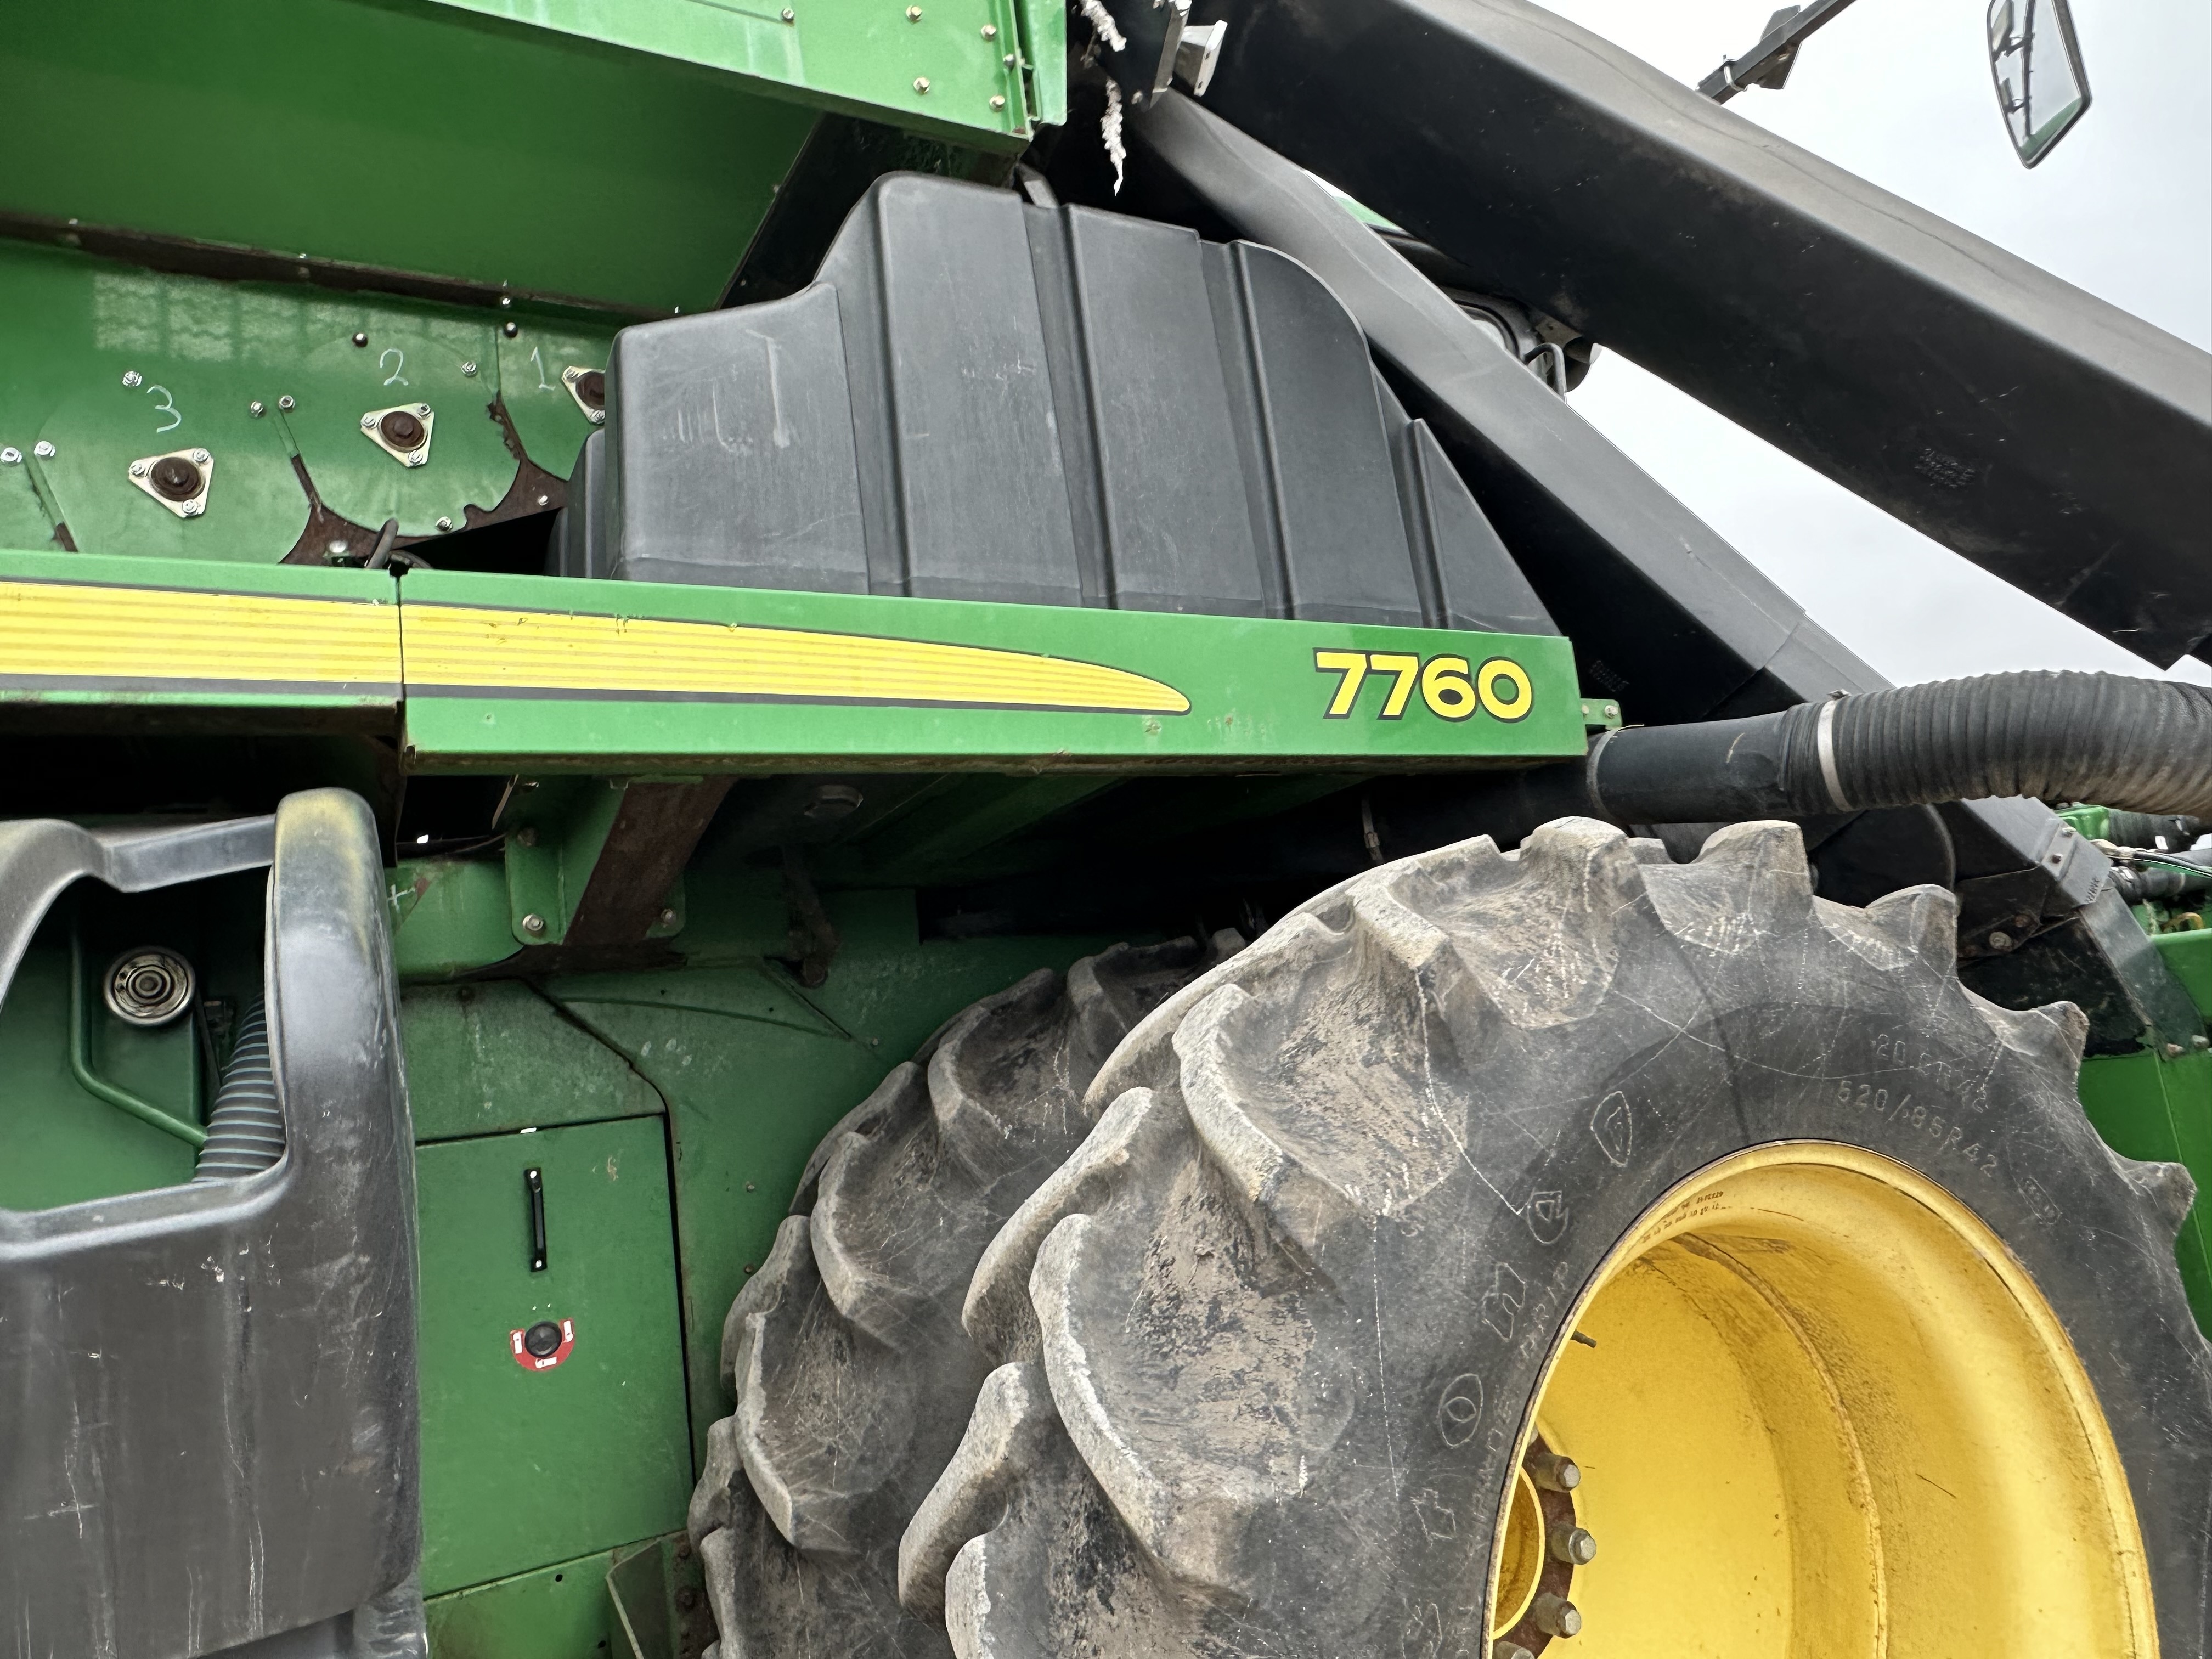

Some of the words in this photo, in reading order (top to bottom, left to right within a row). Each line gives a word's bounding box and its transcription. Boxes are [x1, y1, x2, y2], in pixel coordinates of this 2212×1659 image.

[380, 348, 409, 386] 2
[531, 346, 555, 391] 1
[146, 384, 182, 433] 3
[1312, 647, 1533, 723] 7760
